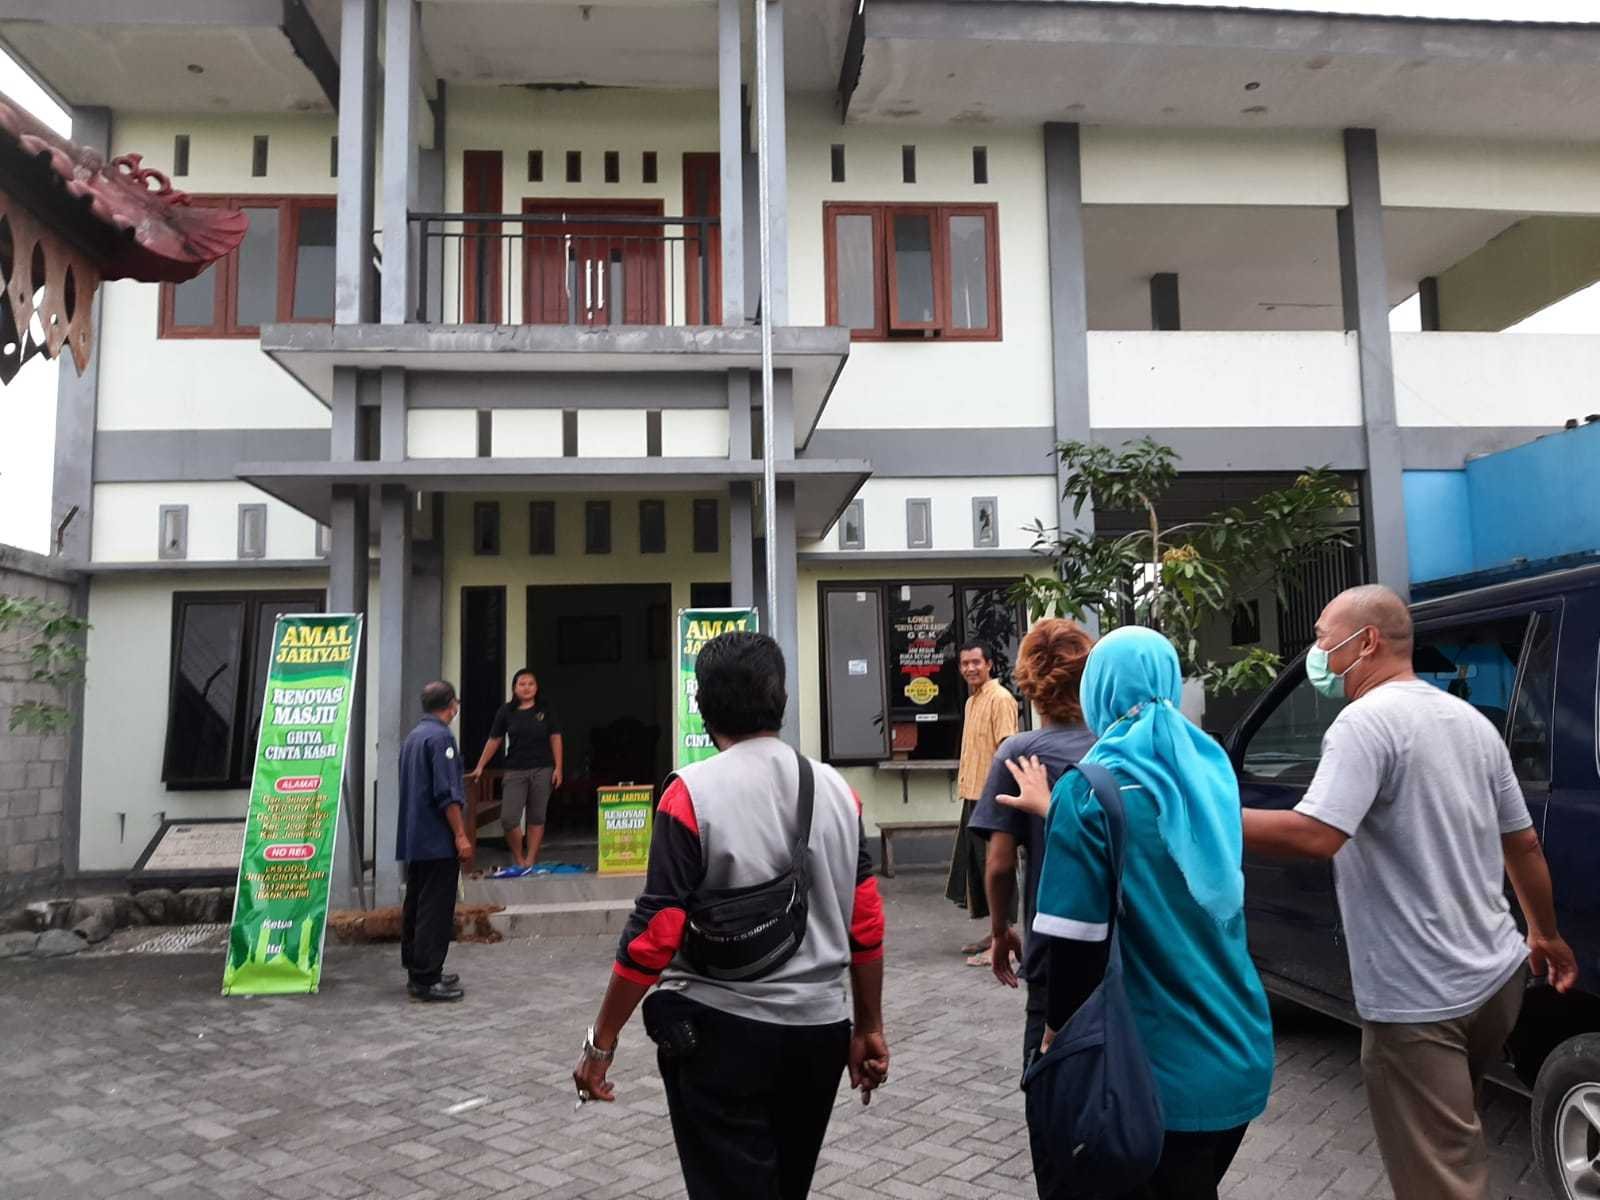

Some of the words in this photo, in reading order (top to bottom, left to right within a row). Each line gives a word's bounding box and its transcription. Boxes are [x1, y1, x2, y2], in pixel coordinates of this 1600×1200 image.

[907, 615, 935, 624] LOKET
[279, 625, 353, 647] AMAL
[286, 730, 322, 745] GRIYA
[686, 733, 714, 748] CINT
[264, 745, 301, 760] CINTA
[281, 779, 320, 789] ALAMAT
[600, 792, 621, 803] AMAL
[604, 809, 647, 820] RENOVASI
[606, 819, 646, 830] MASJID
[271, 848, 287, 857] NO
[262, 919, 293, 930] Ketua
